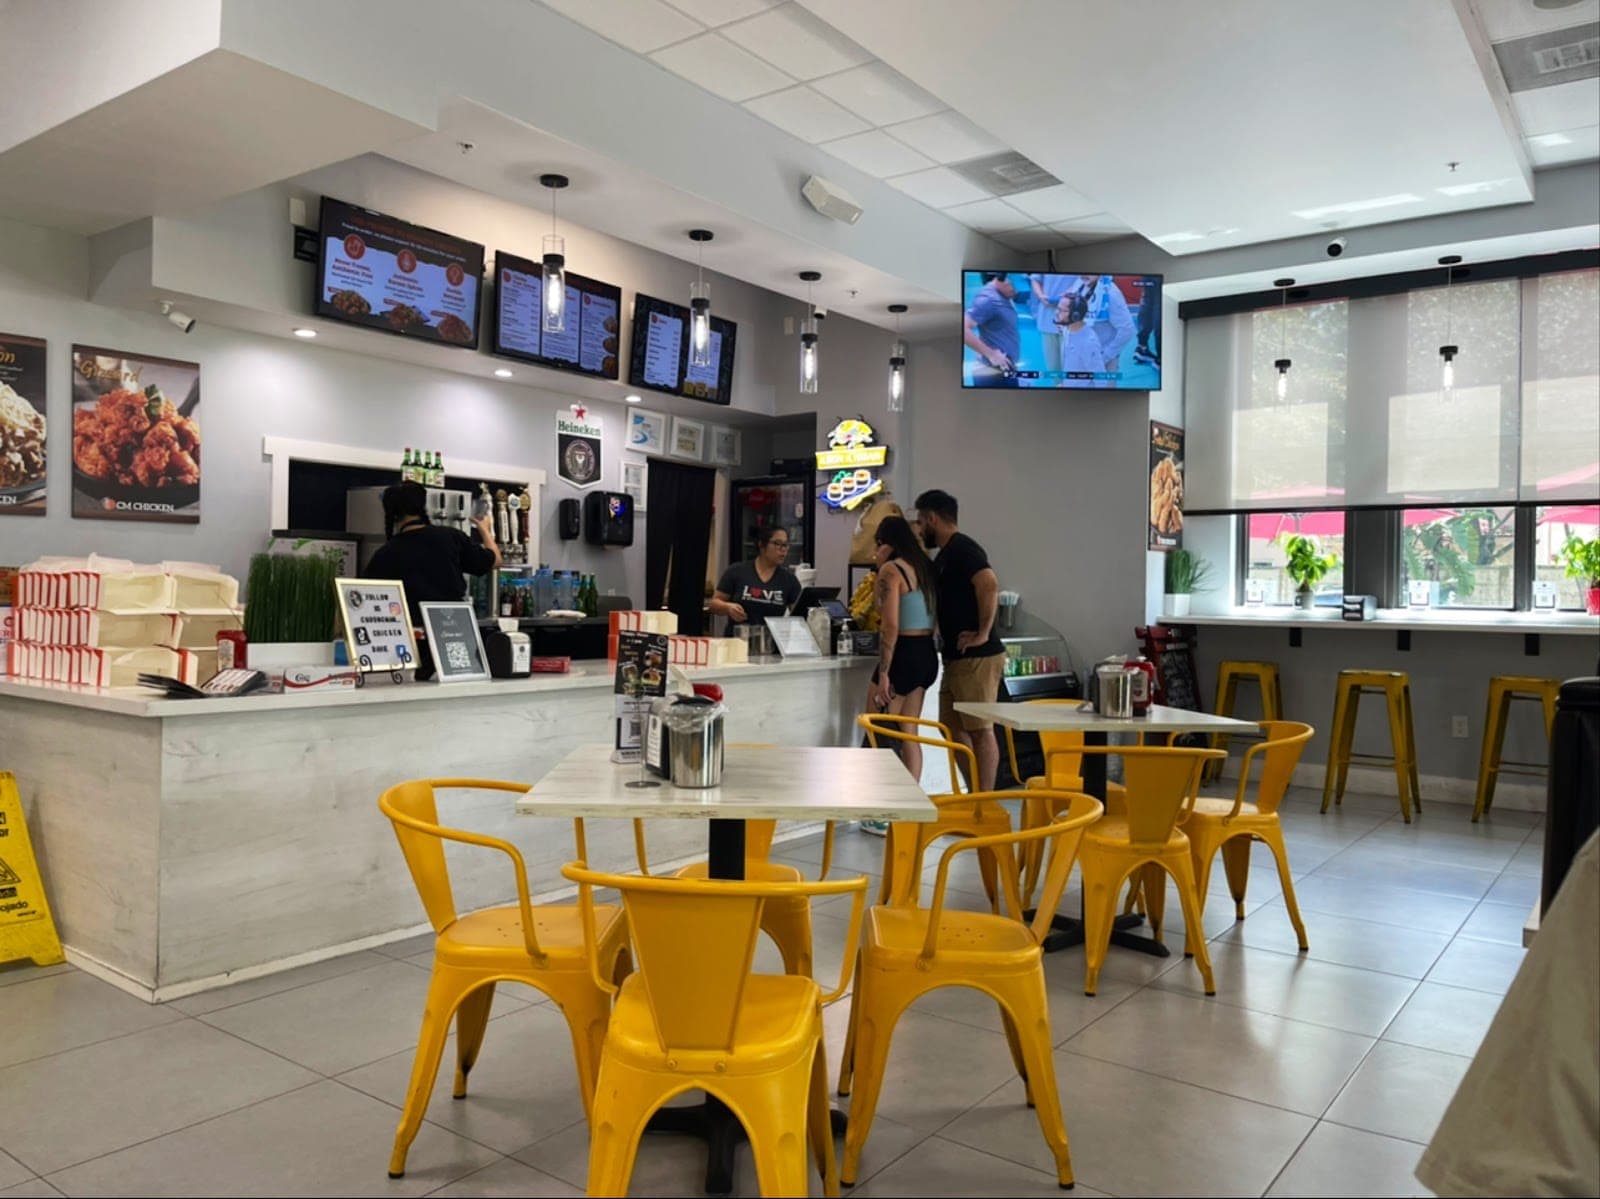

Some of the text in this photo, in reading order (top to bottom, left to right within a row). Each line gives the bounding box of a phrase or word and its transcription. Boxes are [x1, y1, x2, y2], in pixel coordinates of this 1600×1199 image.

[558, 420, 601, 436] Heineken
[116, 501, 175, 512] CM CHICKEN
[365, 593, 389, 601] FOLLOW
[372, 629, 402, 637] CHICKEN
